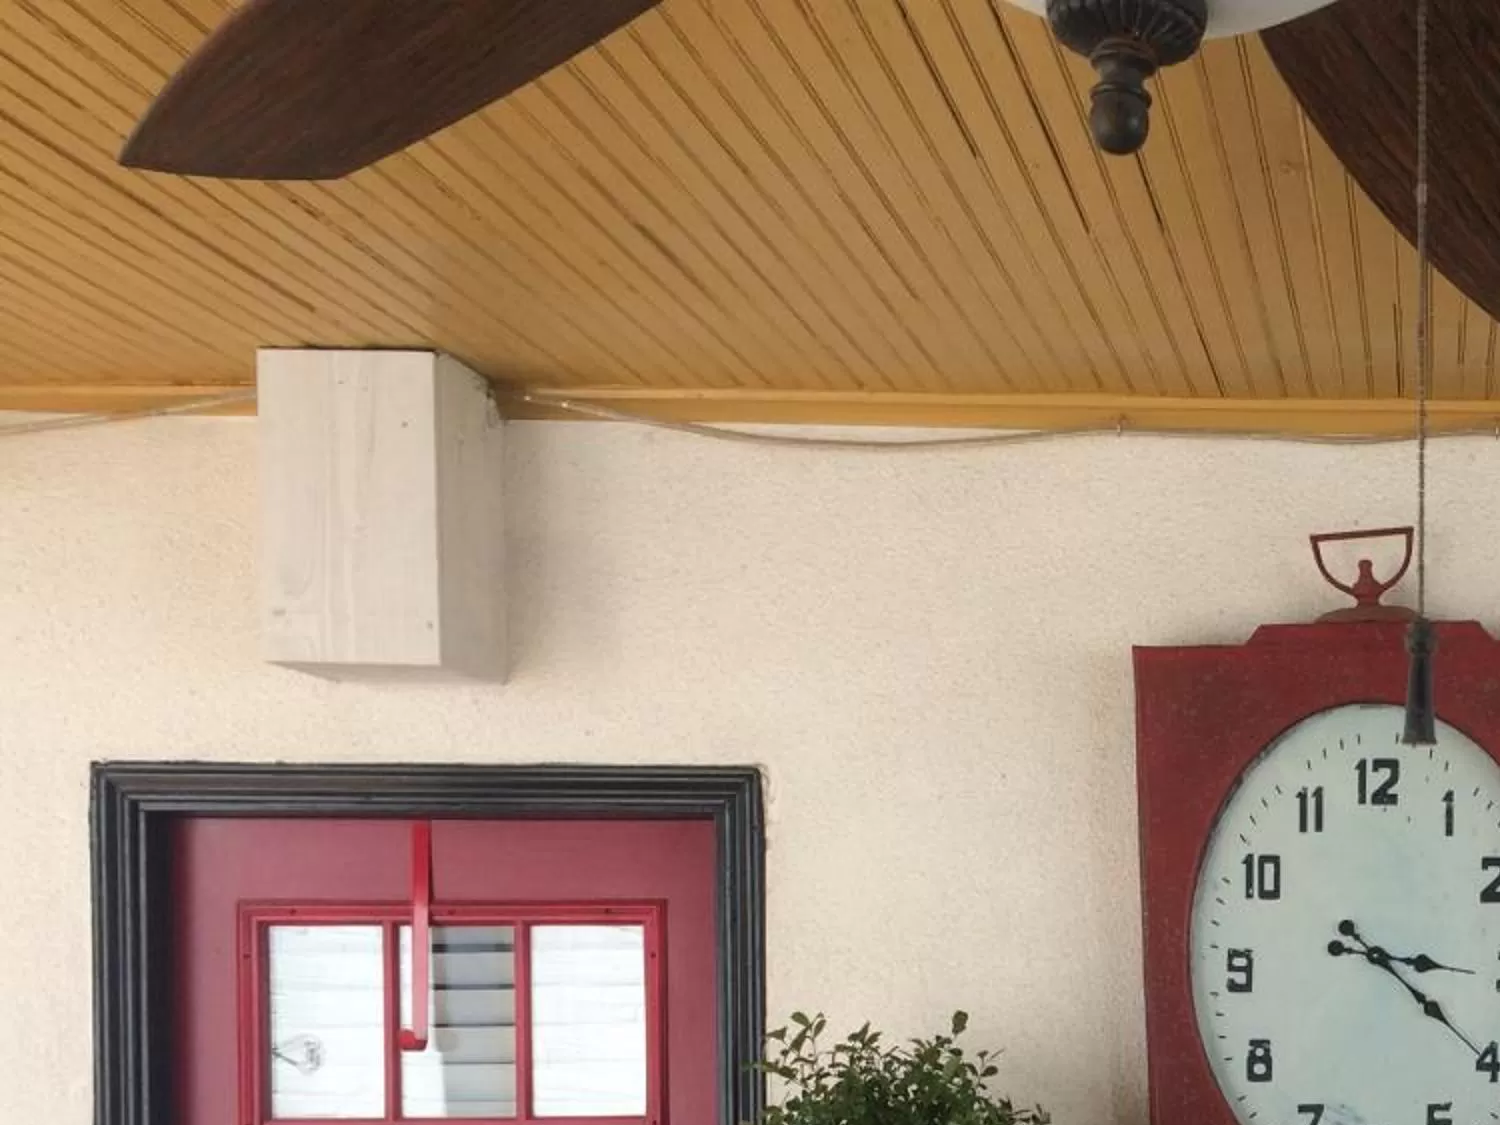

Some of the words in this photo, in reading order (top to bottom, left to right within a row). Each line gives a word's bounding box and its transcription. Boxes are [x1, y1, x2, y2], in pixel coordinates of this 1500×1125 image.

[1354, 757, 1400, 806] 12
[1297, 786, 1325, 834] 11
[1442, 790, 1455, 837] 1
[1241, 853, 1281, 901] 10
[1226, 948, 1254, 993] 9
[1246, 1039, 1273, 1083] 8
[1475, 1041, 1500, 1083] 4
